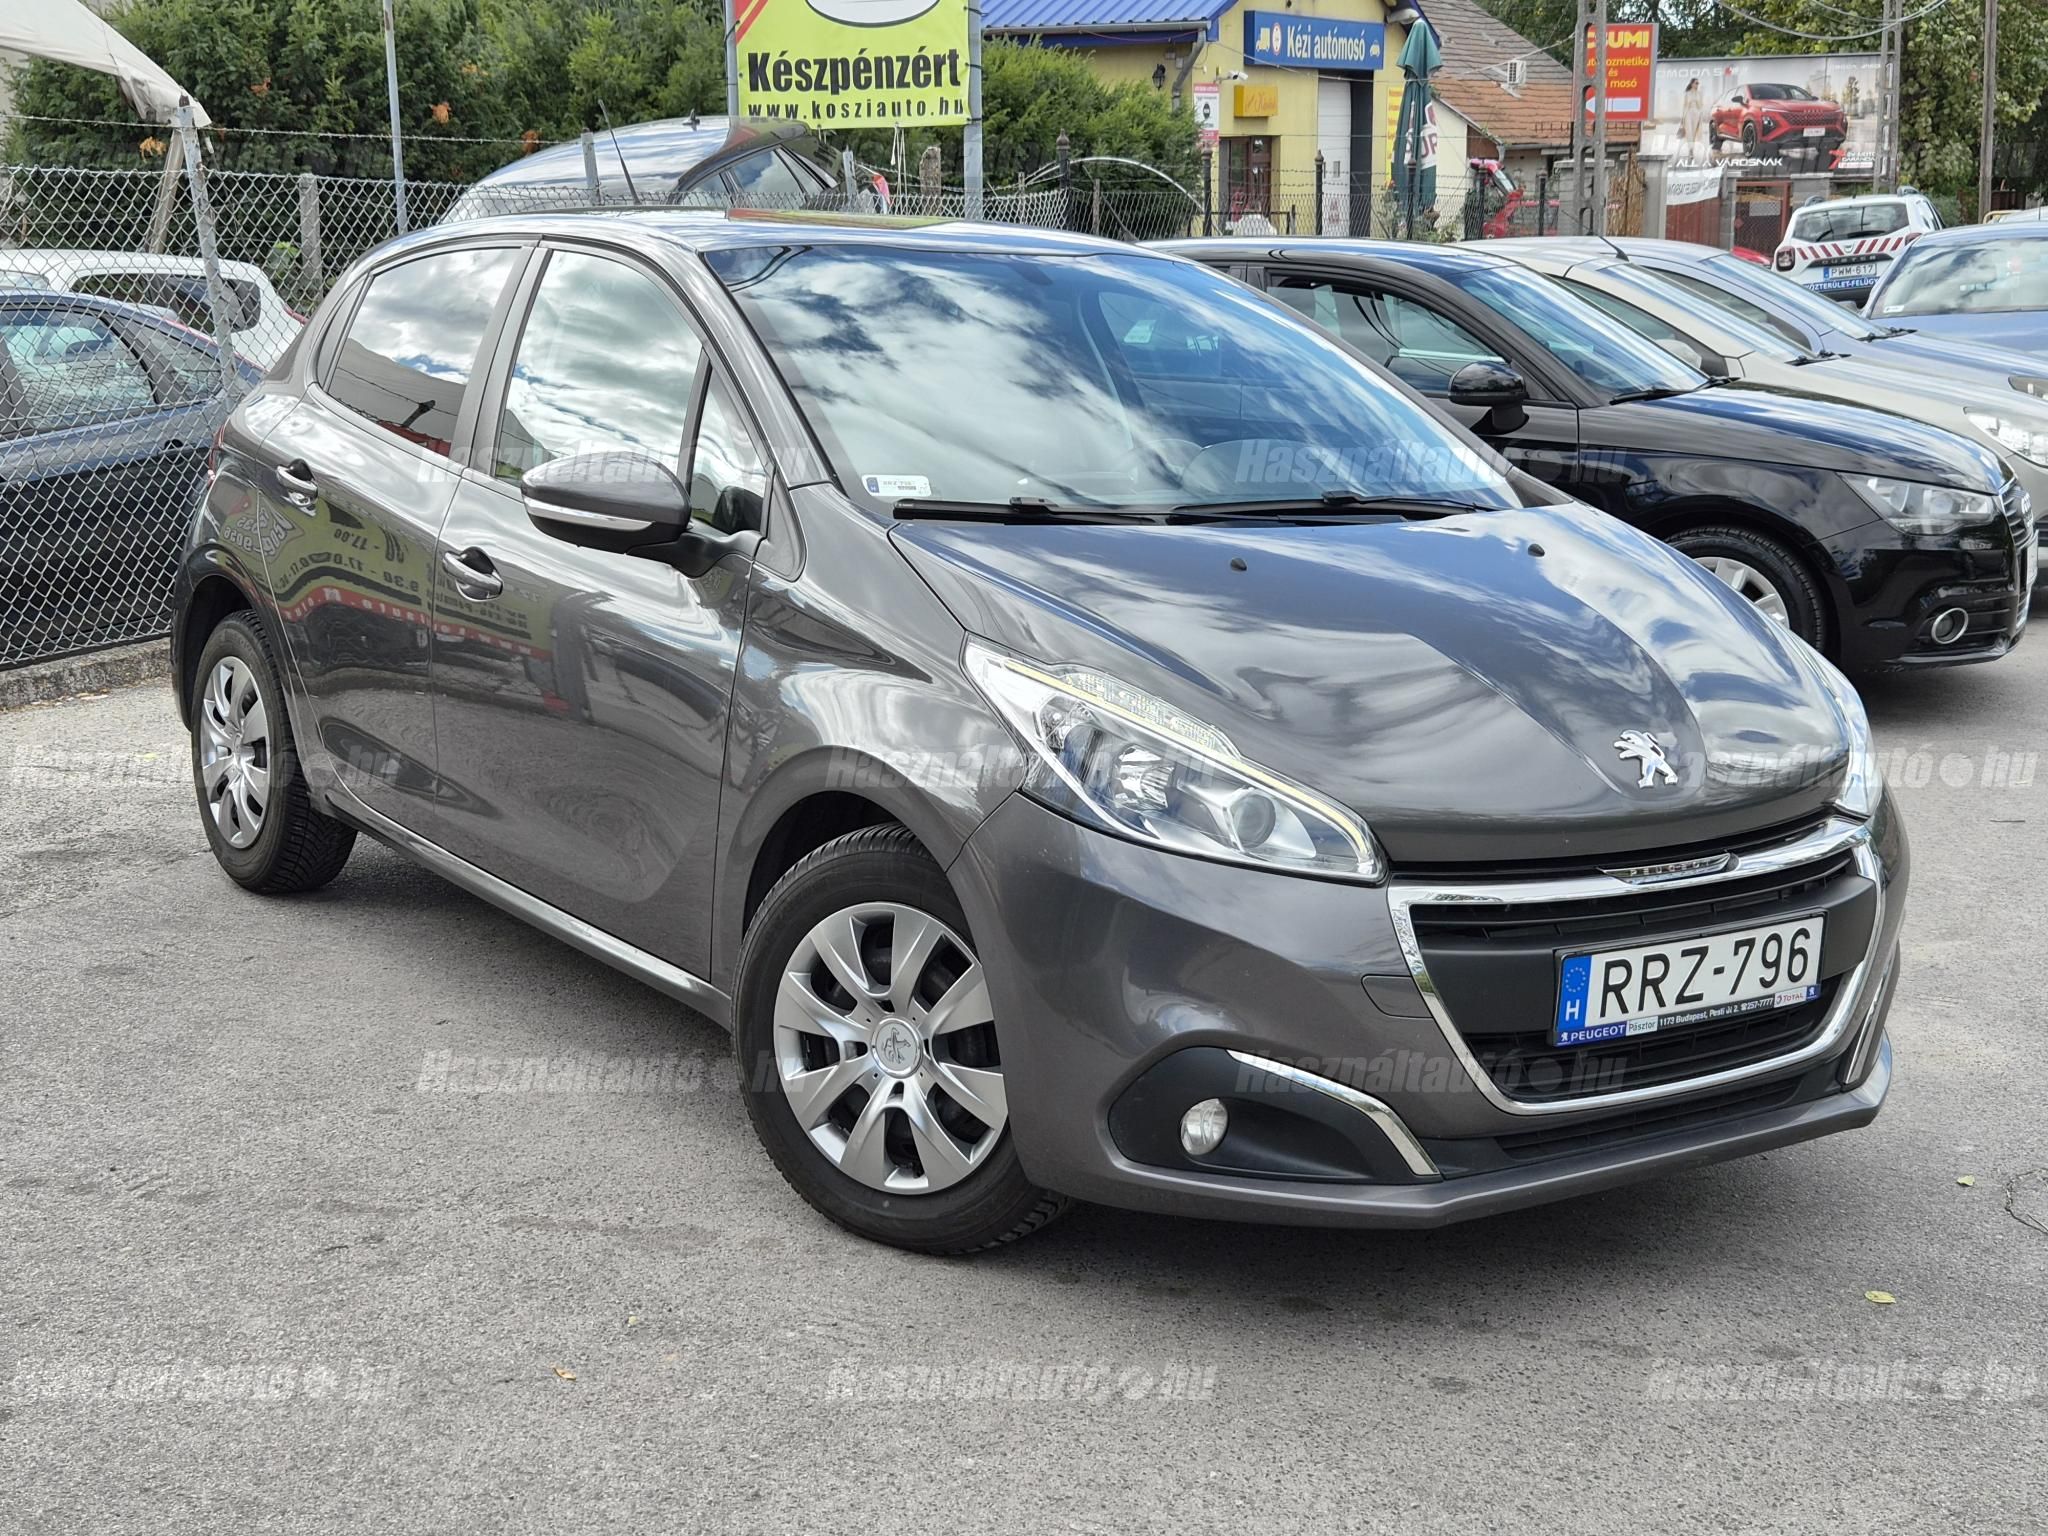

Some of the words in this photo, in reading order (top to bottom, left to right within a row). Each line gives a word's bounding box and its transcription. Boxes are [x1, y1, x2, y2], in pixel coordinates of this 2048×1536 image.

[1287, 24, 1311, 58] Kézi
[1314, 26, 1366, 61] autómosó
[748, 45, 961, 95] Készpénzért
[1608, 68, 1618, 77] és
[1656, 68, 1711, 78] OMODA
[1610, 78, 1637, 88] mosó
[748, 97, 964, 119] www.kosziauto.hu
[1831, 264, 1874, 277] PWM-617
[1599, 927, 1811, 1018] RRZ-796
[1783, 993, 1804, 1003] TOTAL
[1564, 1000, 1580, 1021] H
[1659, 1016, 1675, 1027] 1173
[1570, 1024, 1626, 1043] PEUGEOT
